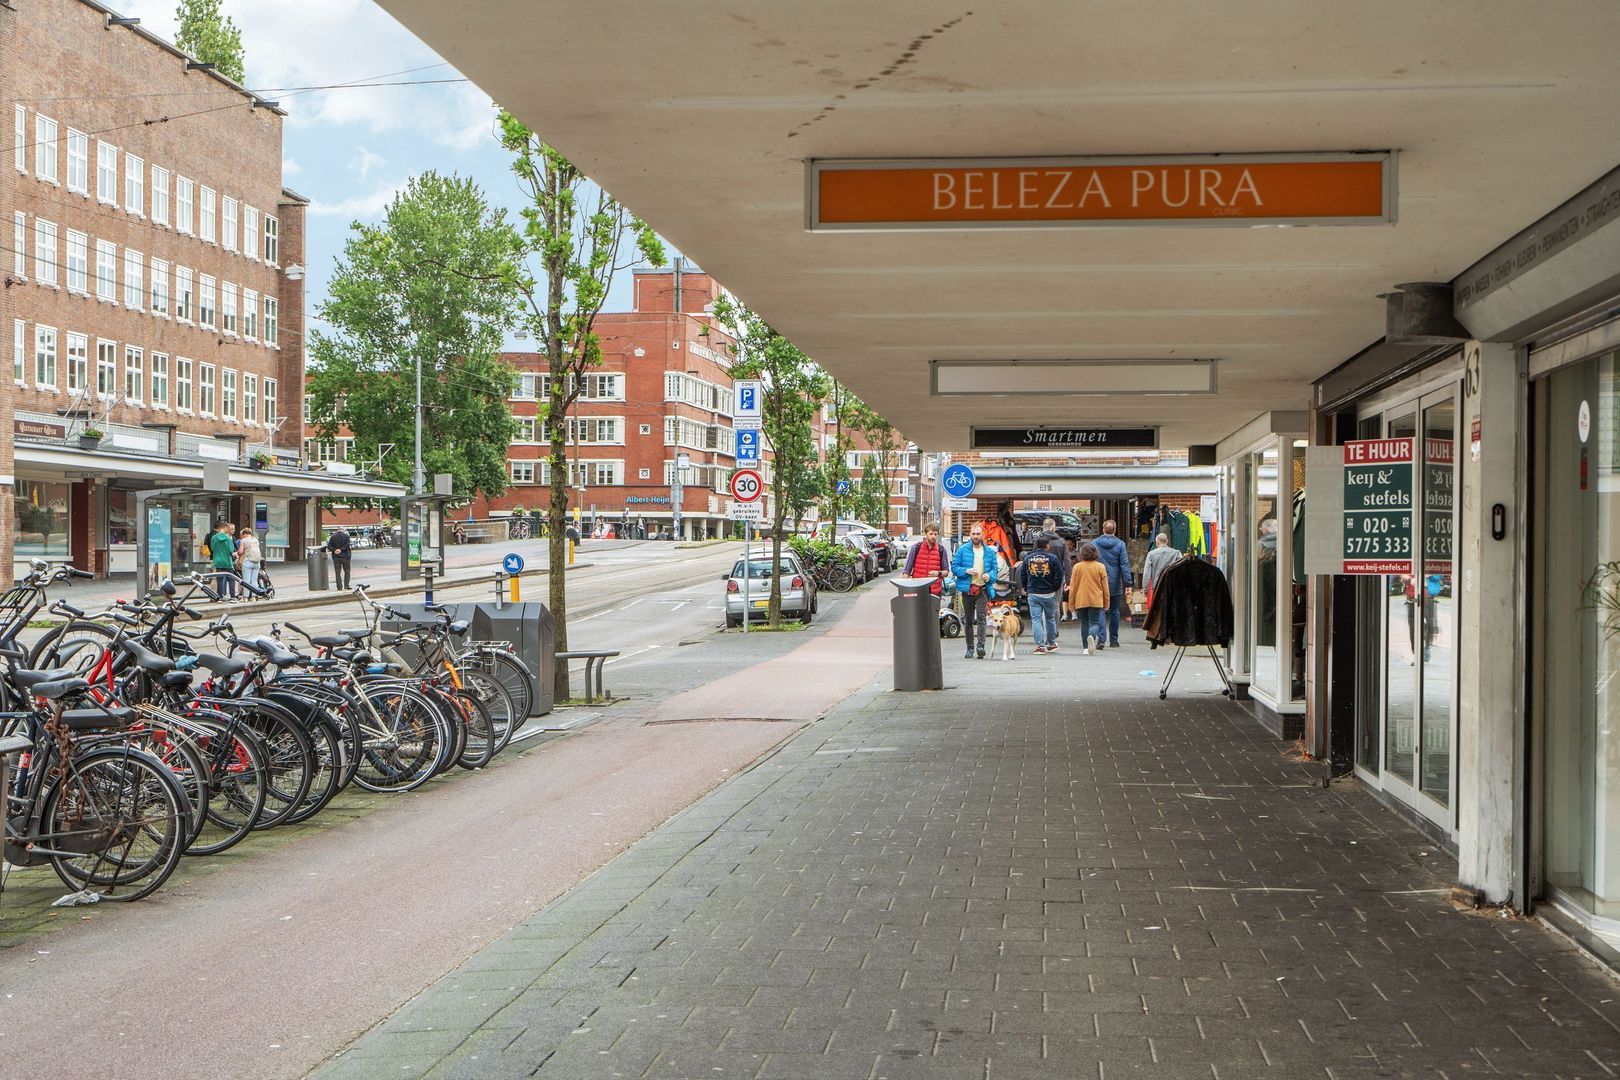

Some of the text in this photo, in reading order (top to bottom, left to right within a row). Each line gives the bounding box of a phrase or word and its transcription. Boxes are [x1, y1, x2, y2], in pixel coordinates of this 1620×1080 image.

[932, 168, 1264, 210] BELEZA PURA
[1465, 347, 1480, 398] 63
[743, 389, 752, 401] P
[1023, 428, 1107, 444] Smartmen
[1347, 441, 1410, 460] TE HUUR
[737, 479, 757, 492] 30
[1347, 469, 1393, 489] keij &
[651, 496, 670, 504] Heijn
[1363, 489, 1410, 506] stefels
[1363, 517, 1396, 533] 020-
[1346, 537, 1410, 553] 5775 333
[1346, 563, 1410, 572] www.keij-stefels.nl
